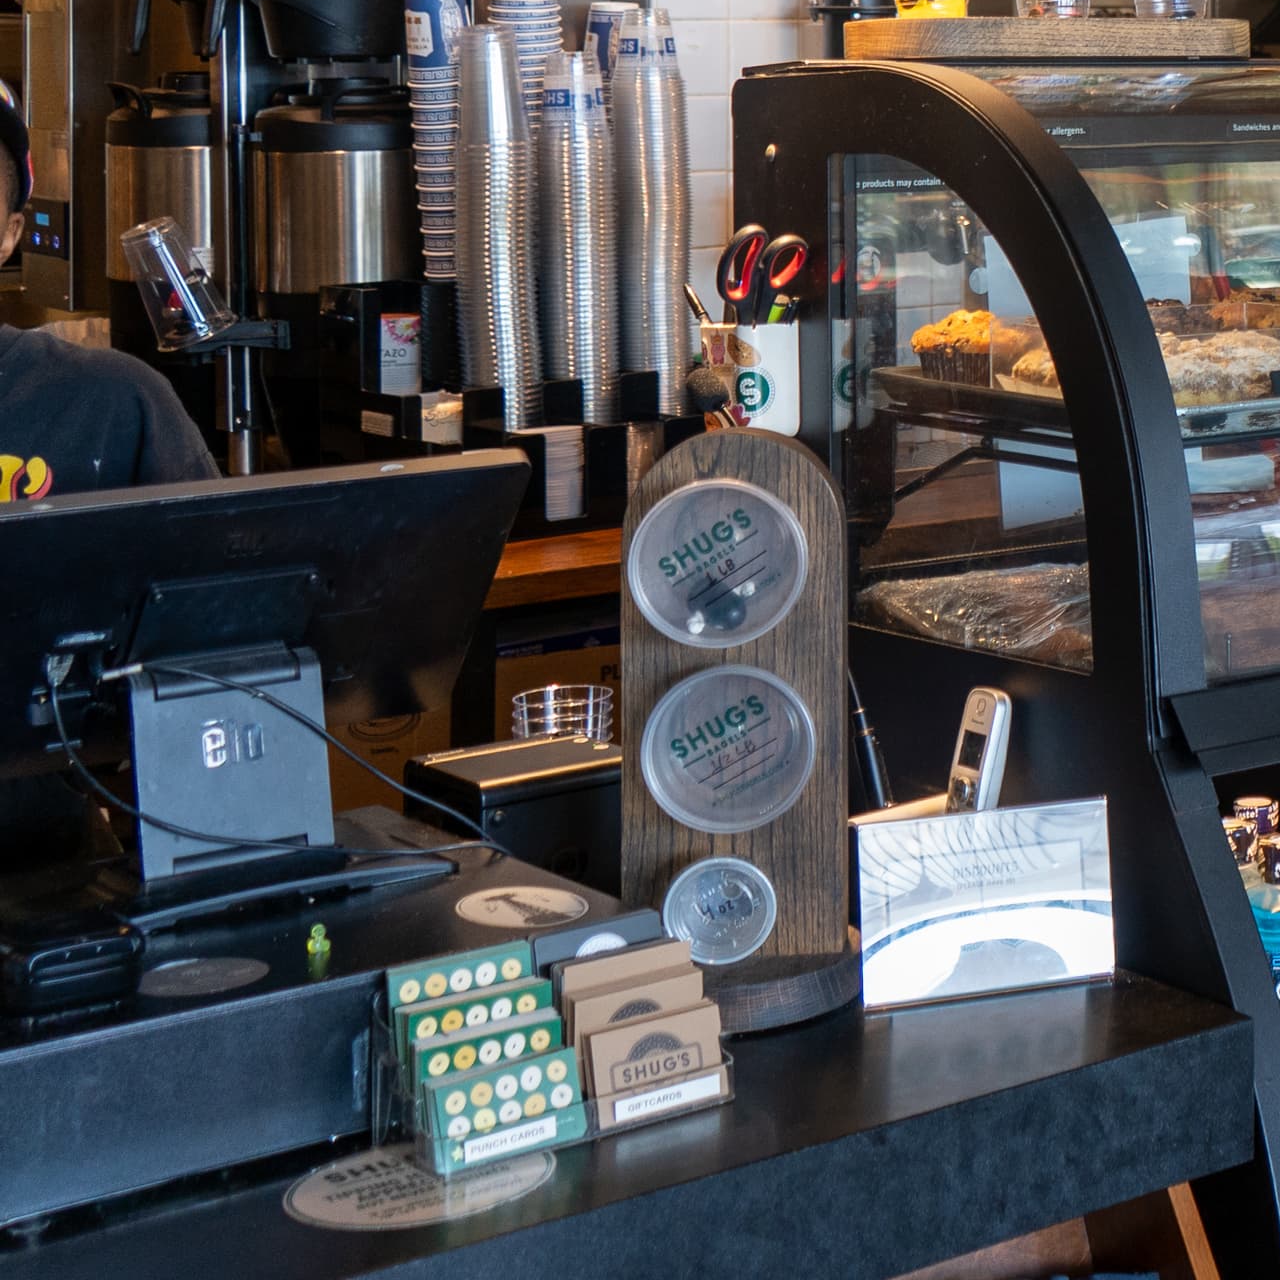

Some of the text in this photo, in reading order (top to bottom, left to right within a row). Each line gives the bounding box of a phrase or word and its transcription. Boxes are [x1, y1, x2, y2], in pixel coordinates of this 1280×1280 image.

[1233, 123, 1270, 132] Sandwiches
[658, 507, 752, 578] SHUG'S
[670, 693, 765, 760] SHUG'S
[622, 1052, 691, 1084] SHUG'S
[628, 1091, 682, 1112] GIFTCARDS
[470, 1126, 545, 1155] PUNCH CARDS
